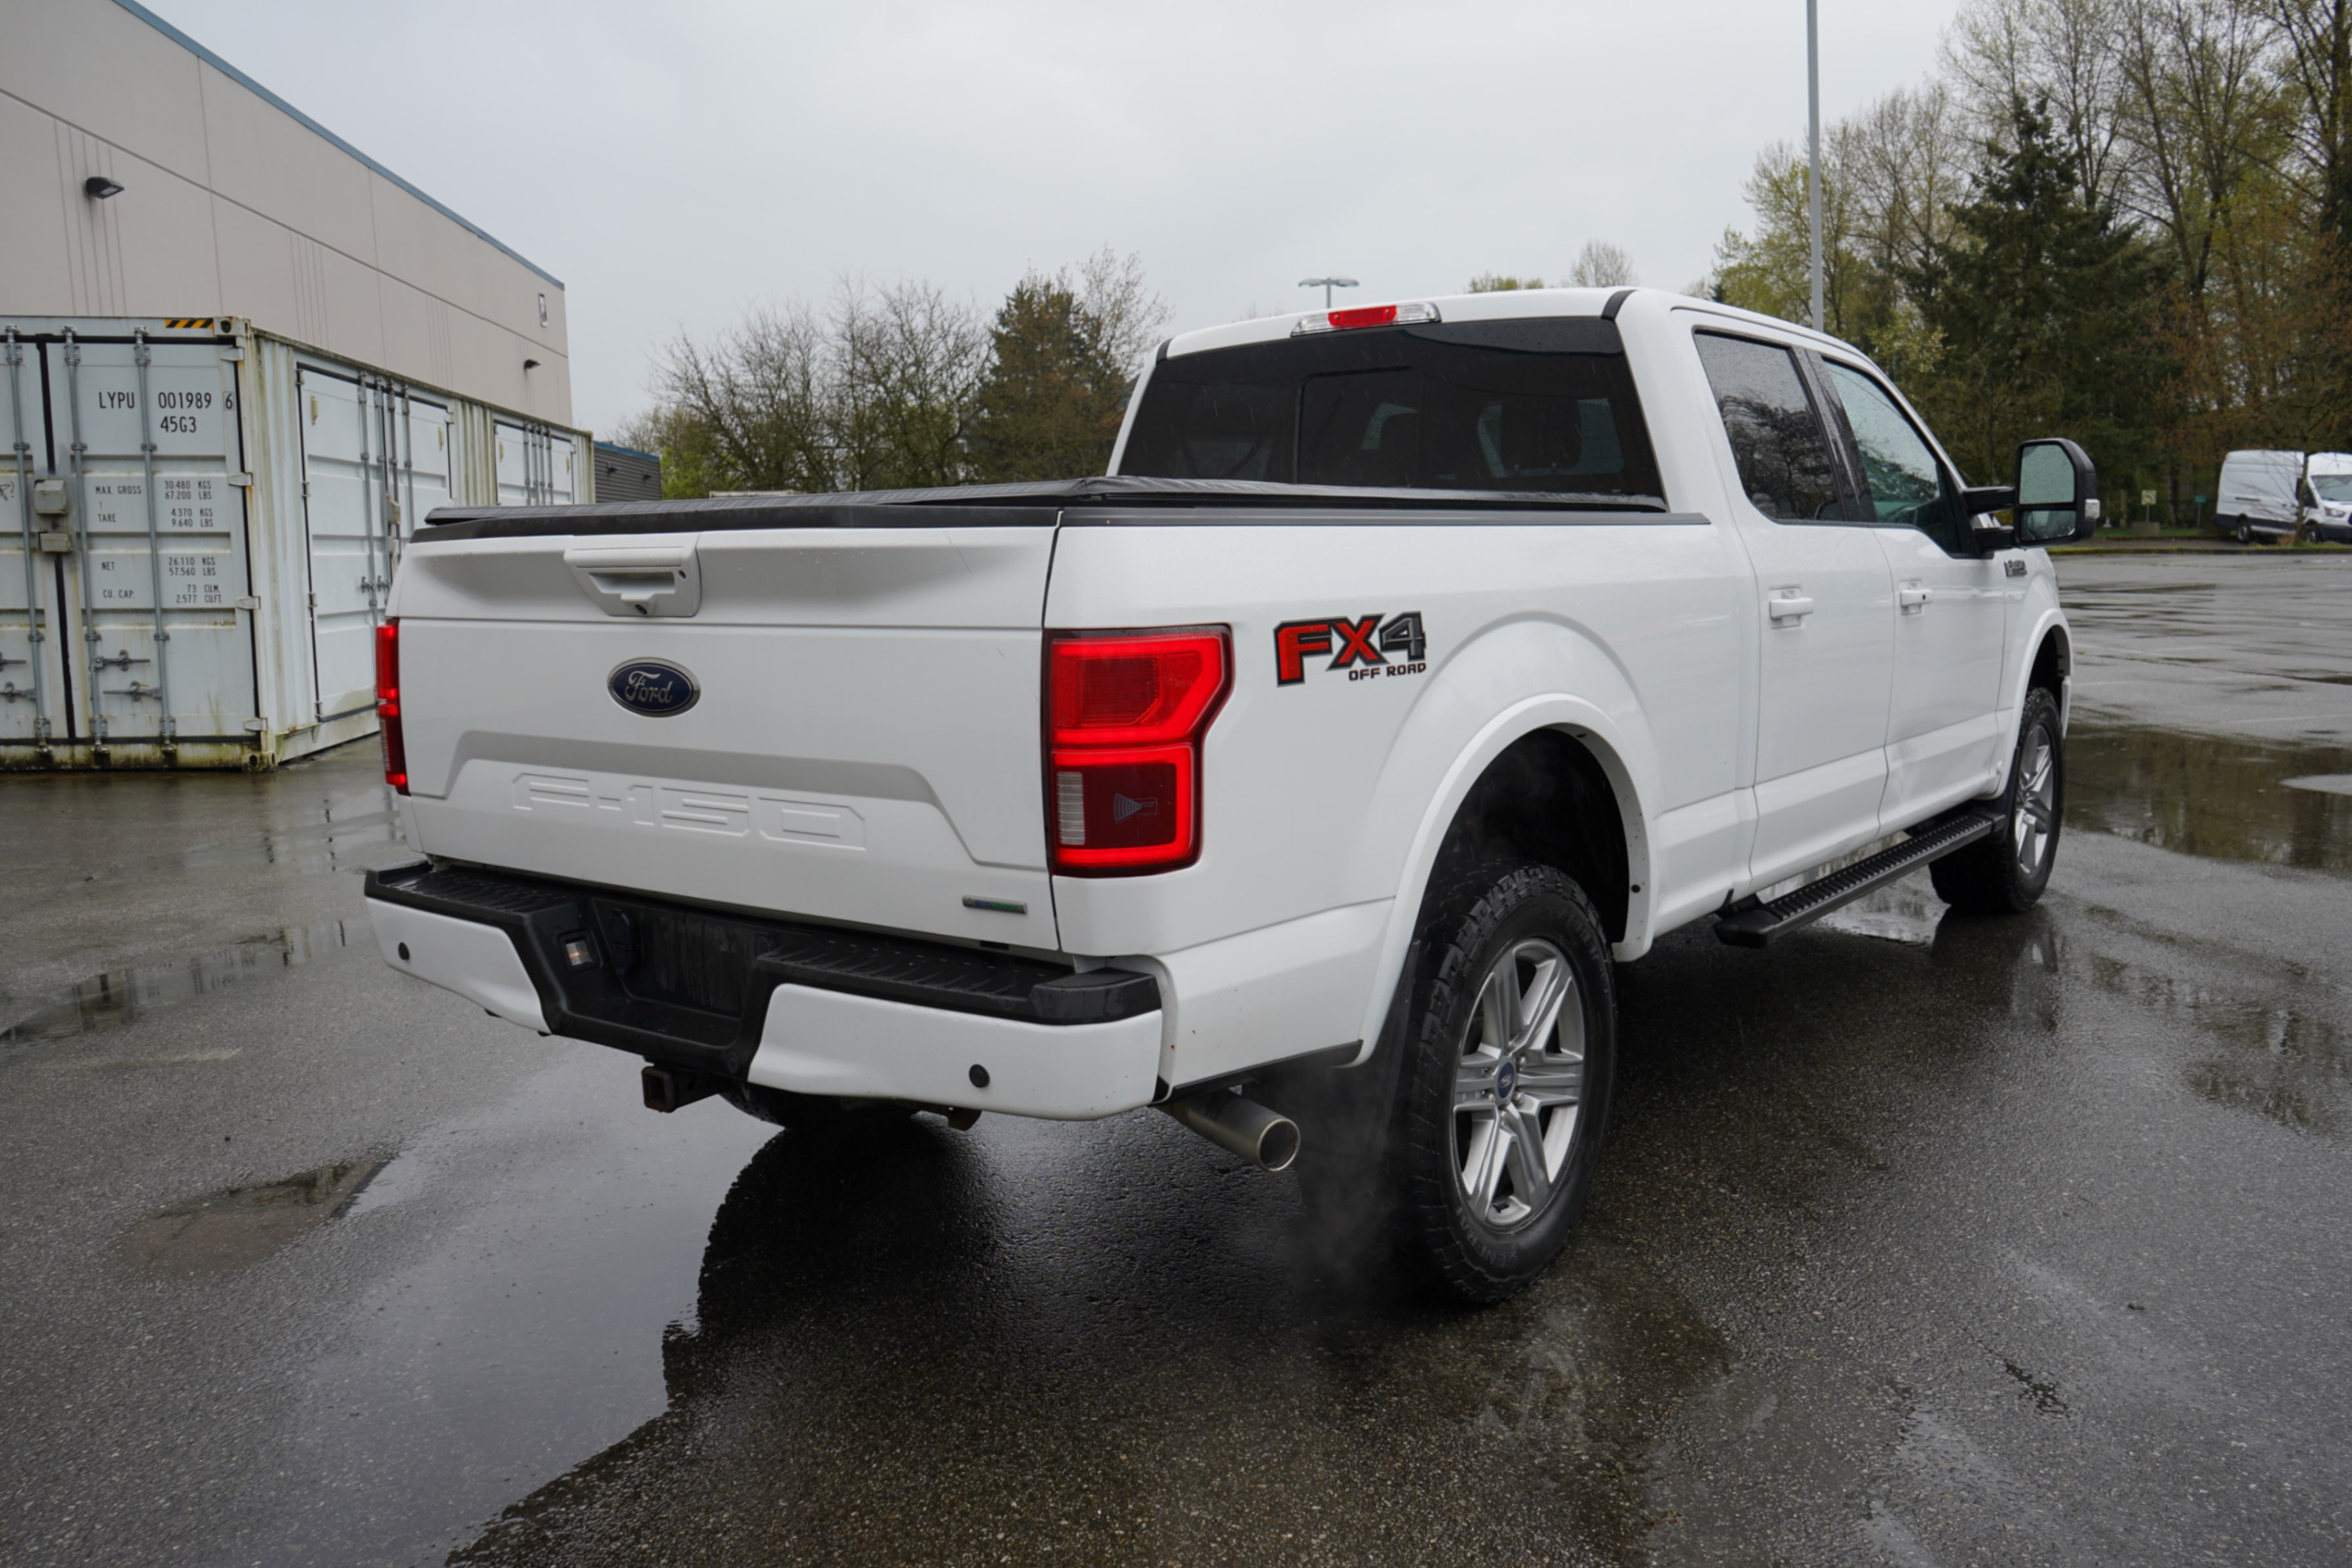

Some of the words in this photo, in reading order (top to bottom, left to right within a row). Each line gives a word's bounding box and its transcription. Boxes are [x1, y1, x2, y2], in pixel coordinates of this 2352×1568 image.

[99, 392, 135, 409] LYPU
[158, 392, 212, 409] 001989
[225, 393, 233, 410] 6
[160, 416, 197, 433] 45G3
[164, 480, 191, 489] 30.480
[198, 480, 212, 490] KGS
[96, 486, 115, 495] MAX.
[117, 486, 142, 495] GROSS
[165, 491, 191, 500] 67.200
[199, 490, 212, 500] LBS
[98, 513, 117, 523] TARE
[171, 508, 193, 518] 4.370
[200, 508, 214, 518] KGS
[172, 518, 193, 527] 9.640
[201, 518, 214, 527] LBS
[102, 562, 115, 571] NET
[168, 557, 195, 566] 26.110
[202, 557, 216, 566] KGS
[169, 567, 196, 577] 57.560
[202, 567, 216, 577] LBS
[187, 584, 197, 594] 73
[103, 590, 115, 599] CU.
[119, 590, 135, 600] CAP.
[176, 594, 197, 604] 2.577
[1273, 611, 1427, 687] FX4
[1349, 667, 1381, 681] OFF
[1386, 662, 1427, 677] ROAD
[625, 670, 674, 703] Ford
[512, 772, 866, 852] F-150
